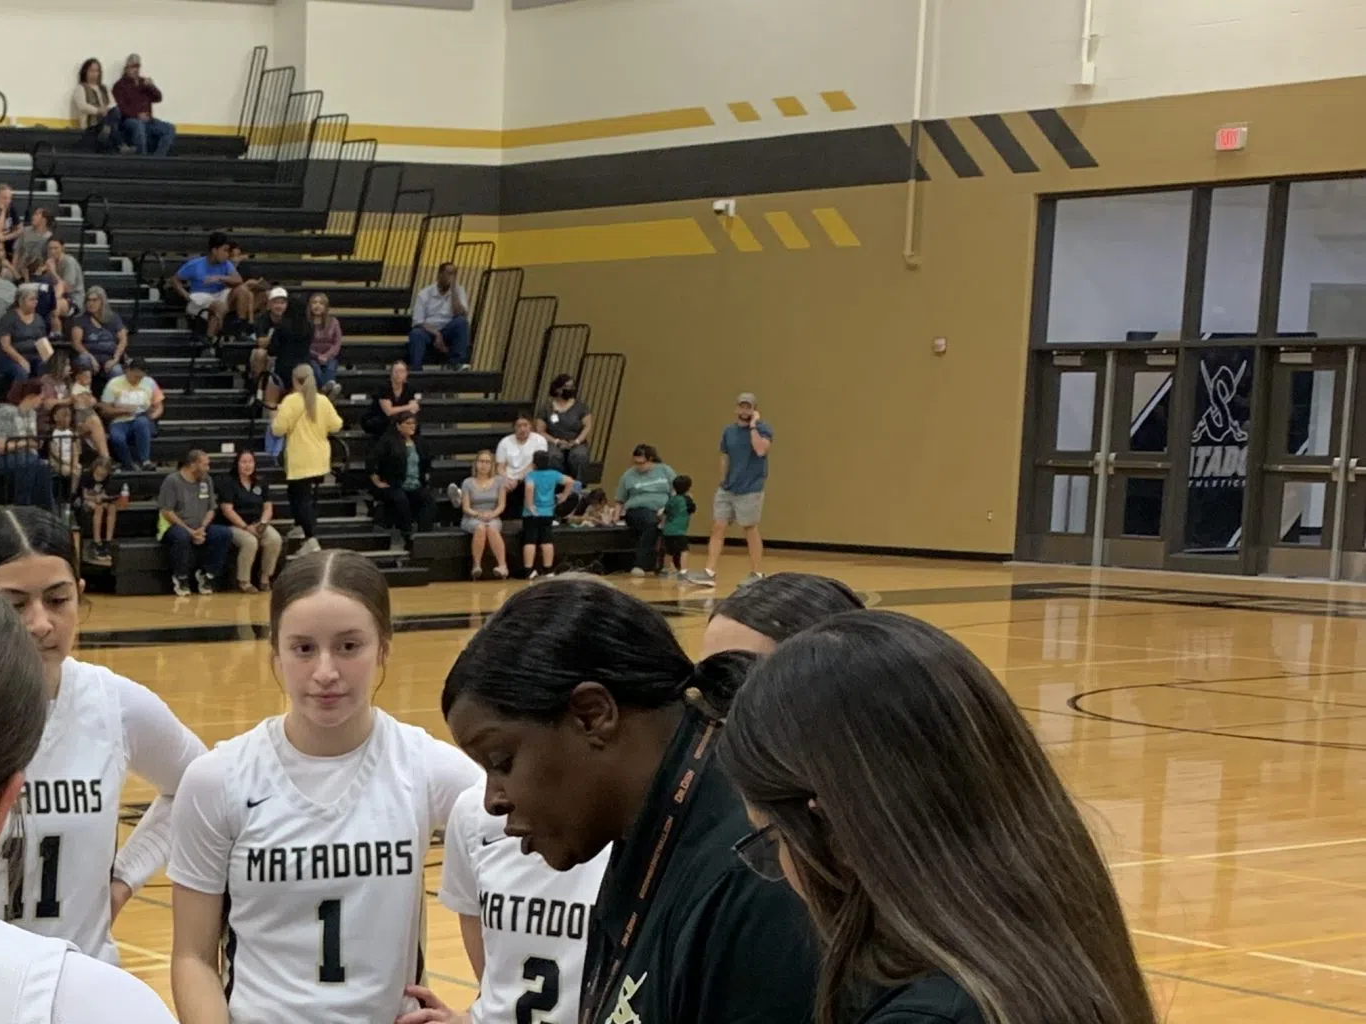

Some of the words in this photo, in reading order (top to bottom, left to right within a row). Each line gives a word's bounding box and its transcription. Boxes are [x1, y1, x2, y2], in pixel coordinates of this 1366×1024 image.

[246, 839, 413, 883] MATADORS
[479, 889, 595, 940] MATADO
[318, 899, 345, 982] 1
